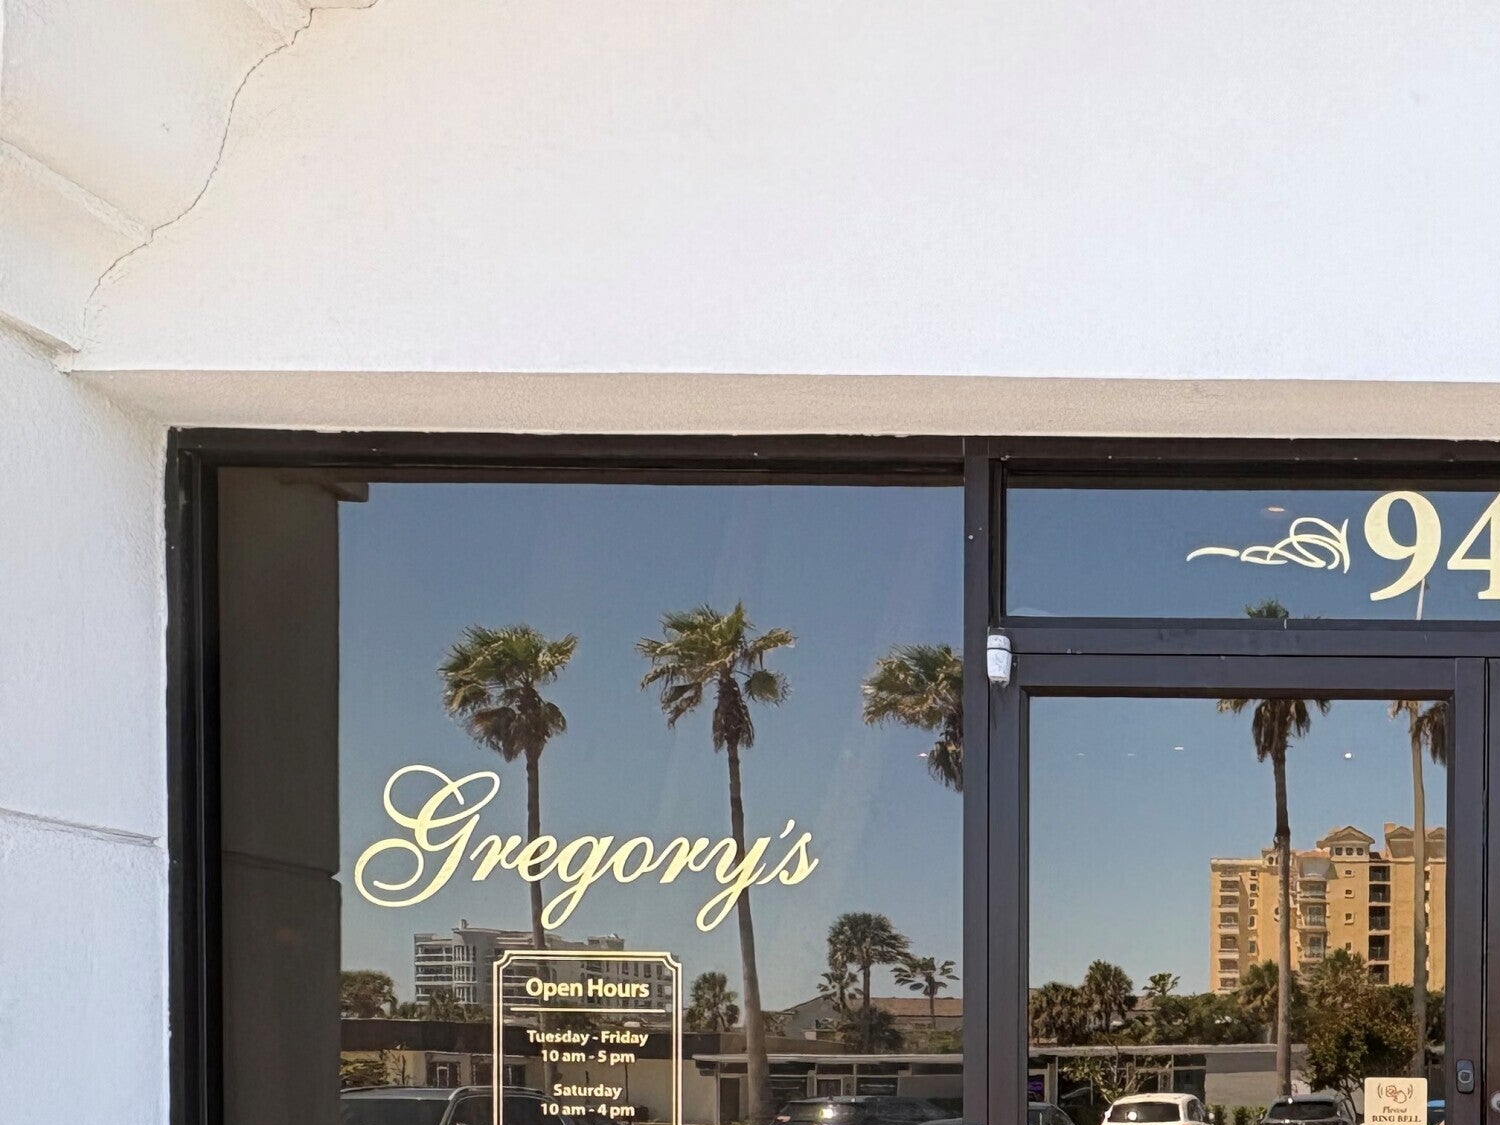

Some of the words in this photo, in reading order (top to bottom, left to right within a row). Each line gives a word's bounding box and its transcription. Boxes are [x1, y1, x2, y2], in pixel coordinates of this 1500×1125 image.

[354, 764, 819, 932] Gregory's
[525, 977, 584, 1001] Open
[587, 978, 650, 998] Hours
[526, 1029, 590, 1046] Tuesday
[601, 1030, 649, 1046] Friday
[541, 1050, 559, 1062] 10
[562, 1052, 586, 1062] am
[597, 1050, 607, 1063] 5
[610, 1053, 635, 1066] pm
[553, 1083, 622, 1100] Saturday
[540, 1103, 559, 1116] 10
[562, 1106, 586, 1116] am
[597, 1104, 607, 1116] 4
[610, 1106, 635, 1119] pm
[1397, 1115, 1421, 1123] BELL
